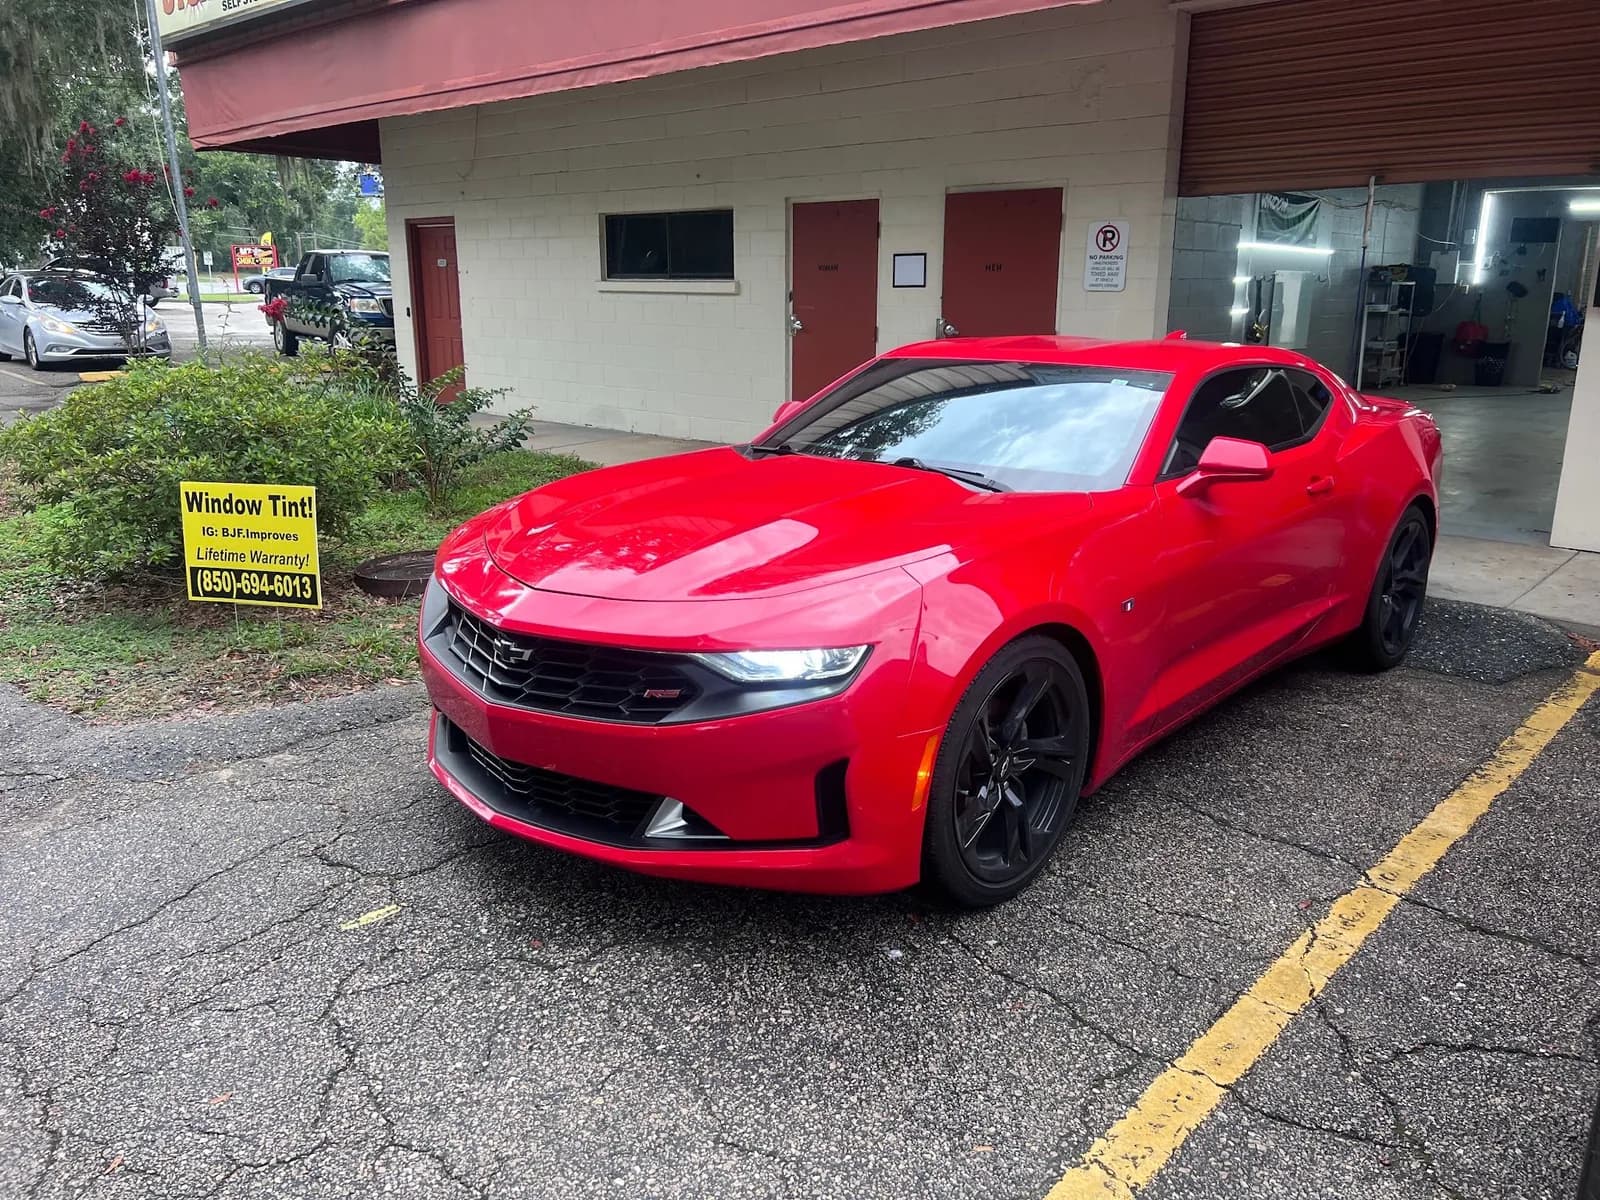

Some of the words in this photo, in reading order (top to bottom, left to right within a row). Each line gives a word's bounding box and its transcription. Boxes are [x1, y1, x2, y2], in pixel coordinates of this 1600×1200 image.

[185, 491, 262, 516] Window
[268, 495, 313, 518] Tint!
[202, 526, 218, 537] IG:
[222, 528, 299, 542] BJF.Improves
[196, 547, 246, 562] Lifetime
[250, 550, 310, 570] Warranty!
[197, 569, 312, 599] (850)-694-6013
[643, 689, 681, 698] RS
